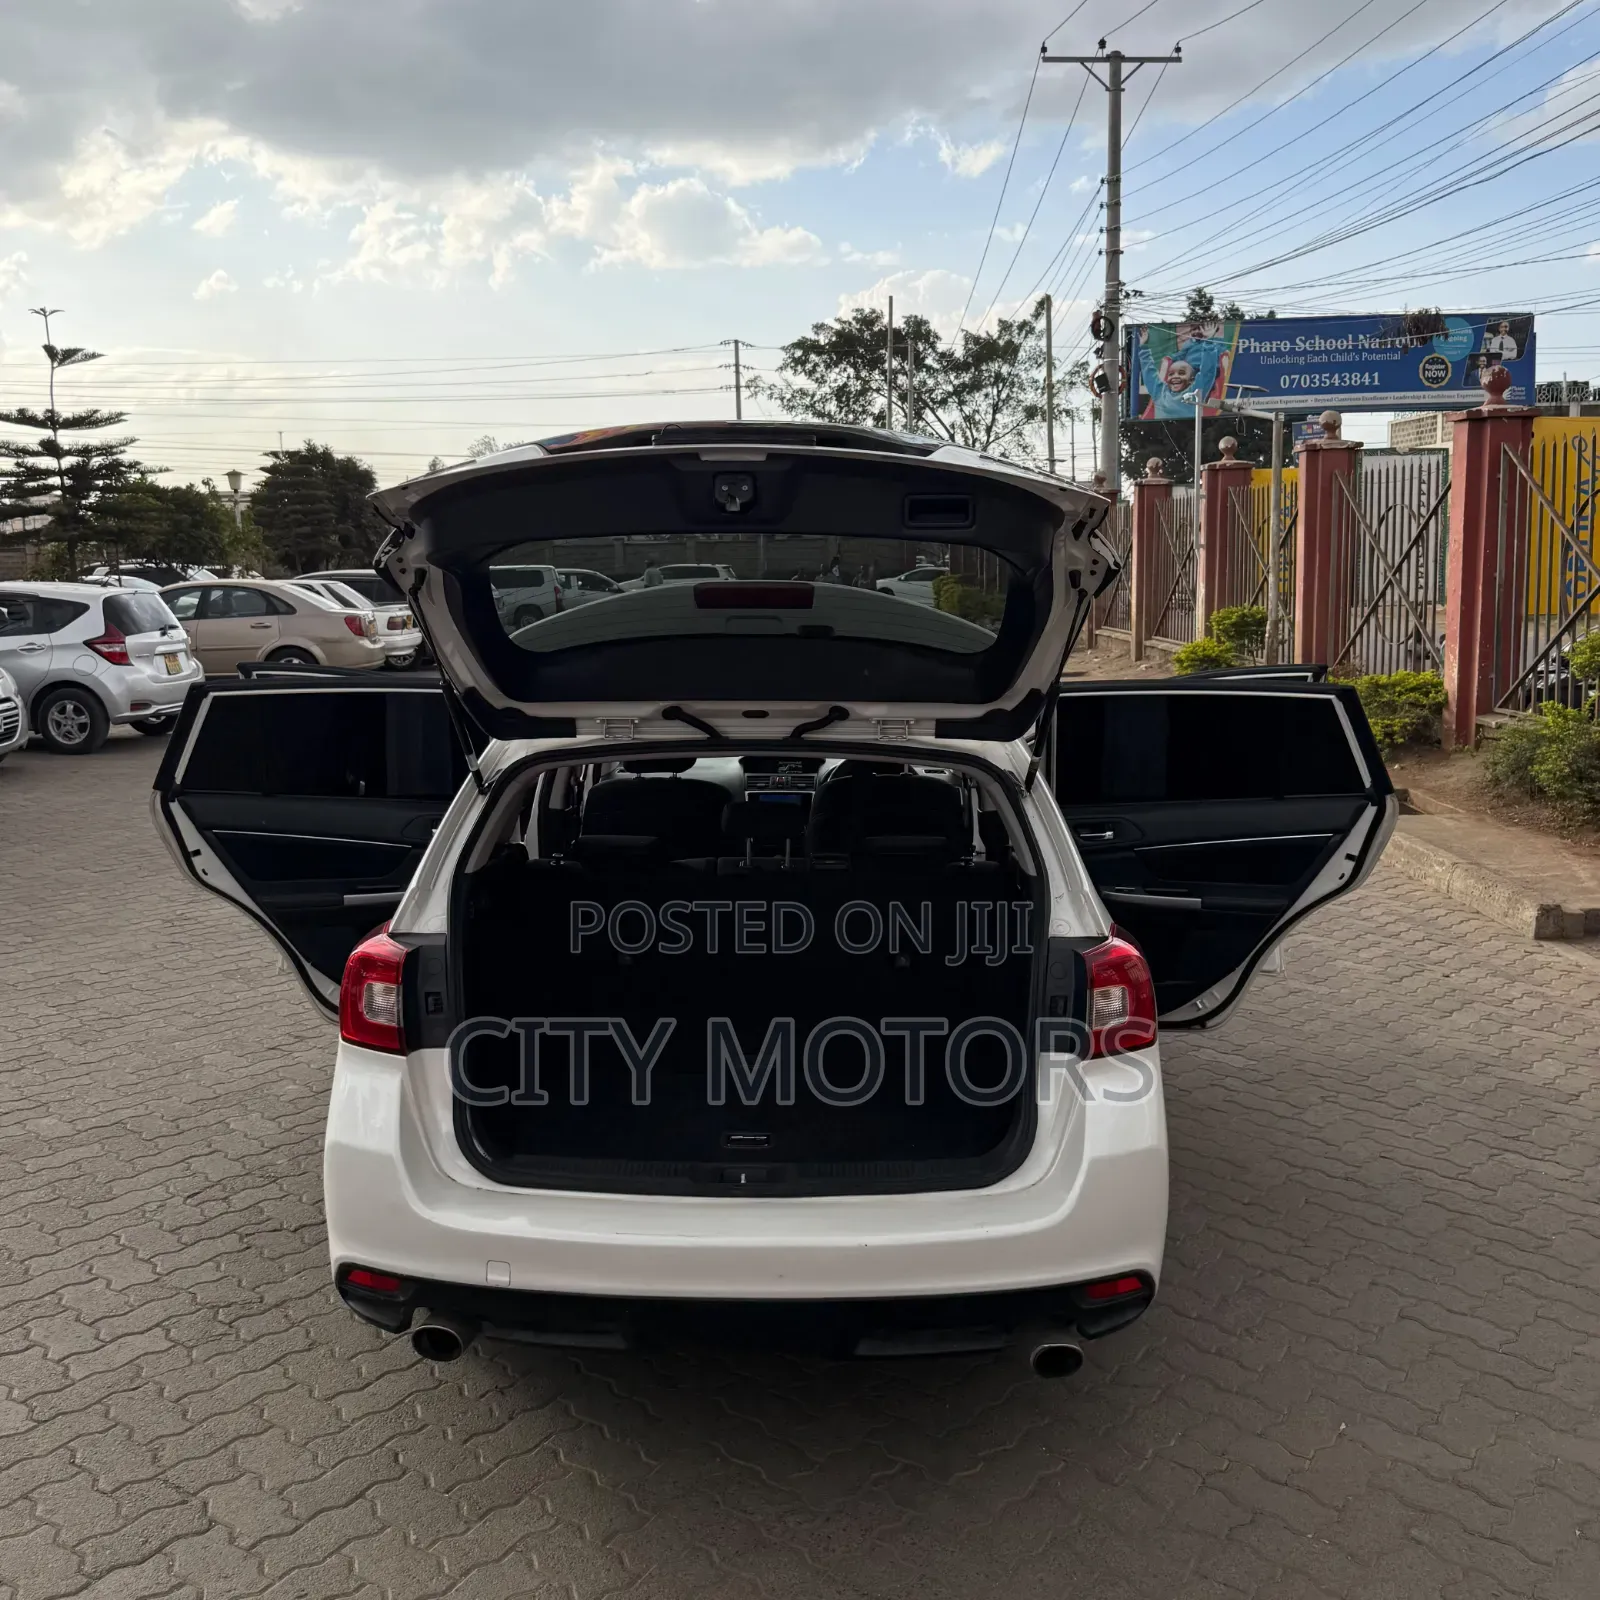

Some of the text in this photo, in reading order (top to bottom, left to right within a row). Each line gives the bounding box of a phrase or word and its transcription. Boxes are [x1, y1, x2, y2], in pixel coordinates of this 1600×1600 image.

[1238, 337, 1291, 354] Pharo
[1295, 334, 1353, 351] School
[1260, 350, 1401, 366] Unlocking Each Child's Potential
[1280, 371, 1381, 389] 0703543841
[1425, 370, 1446, 378] NOW
